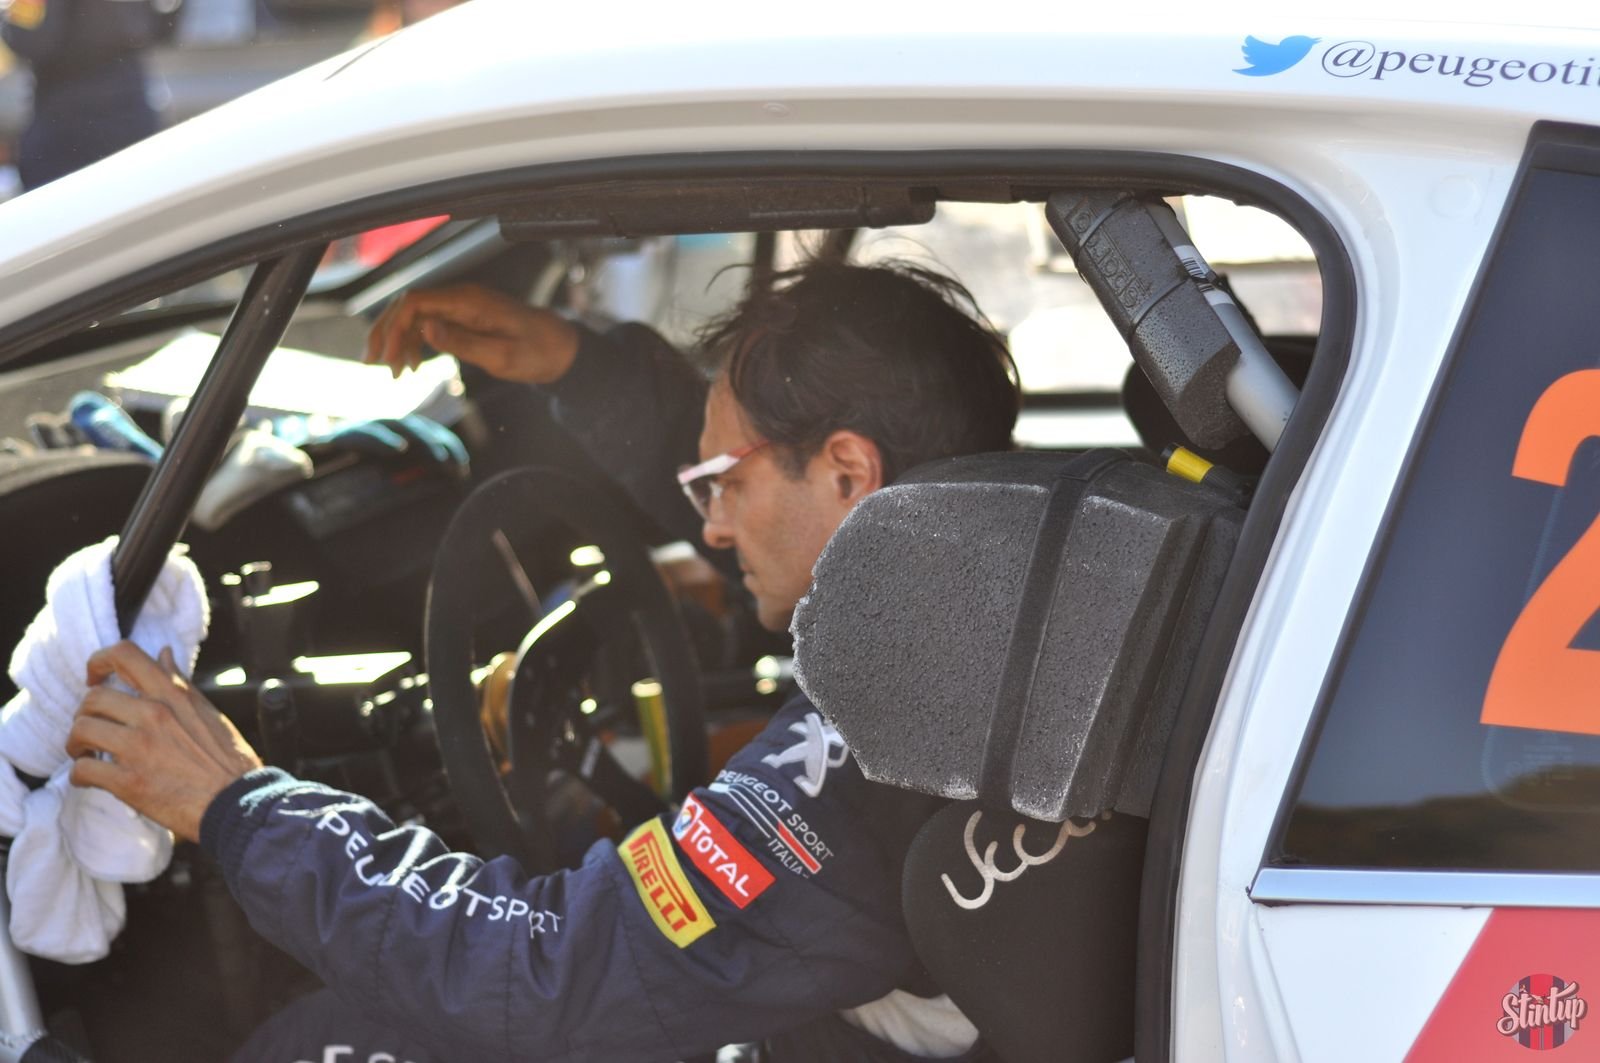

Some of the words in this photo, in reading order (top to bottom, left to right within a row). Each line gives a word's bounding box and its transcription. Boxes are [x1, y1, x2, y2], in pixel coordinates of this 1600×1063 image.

[1321, 40, 1600, 88] @peugeoti
[715, 769, 793, 813] PEUGEOT
[787, 813, 834, 861] SPORT
[627, 830, 698, 933] PIRELLI
[690, 818, 750, 898] TOTAL
[768, 838, 804, 876] ITALIA
[487, 895, 563, 940] SPRT
